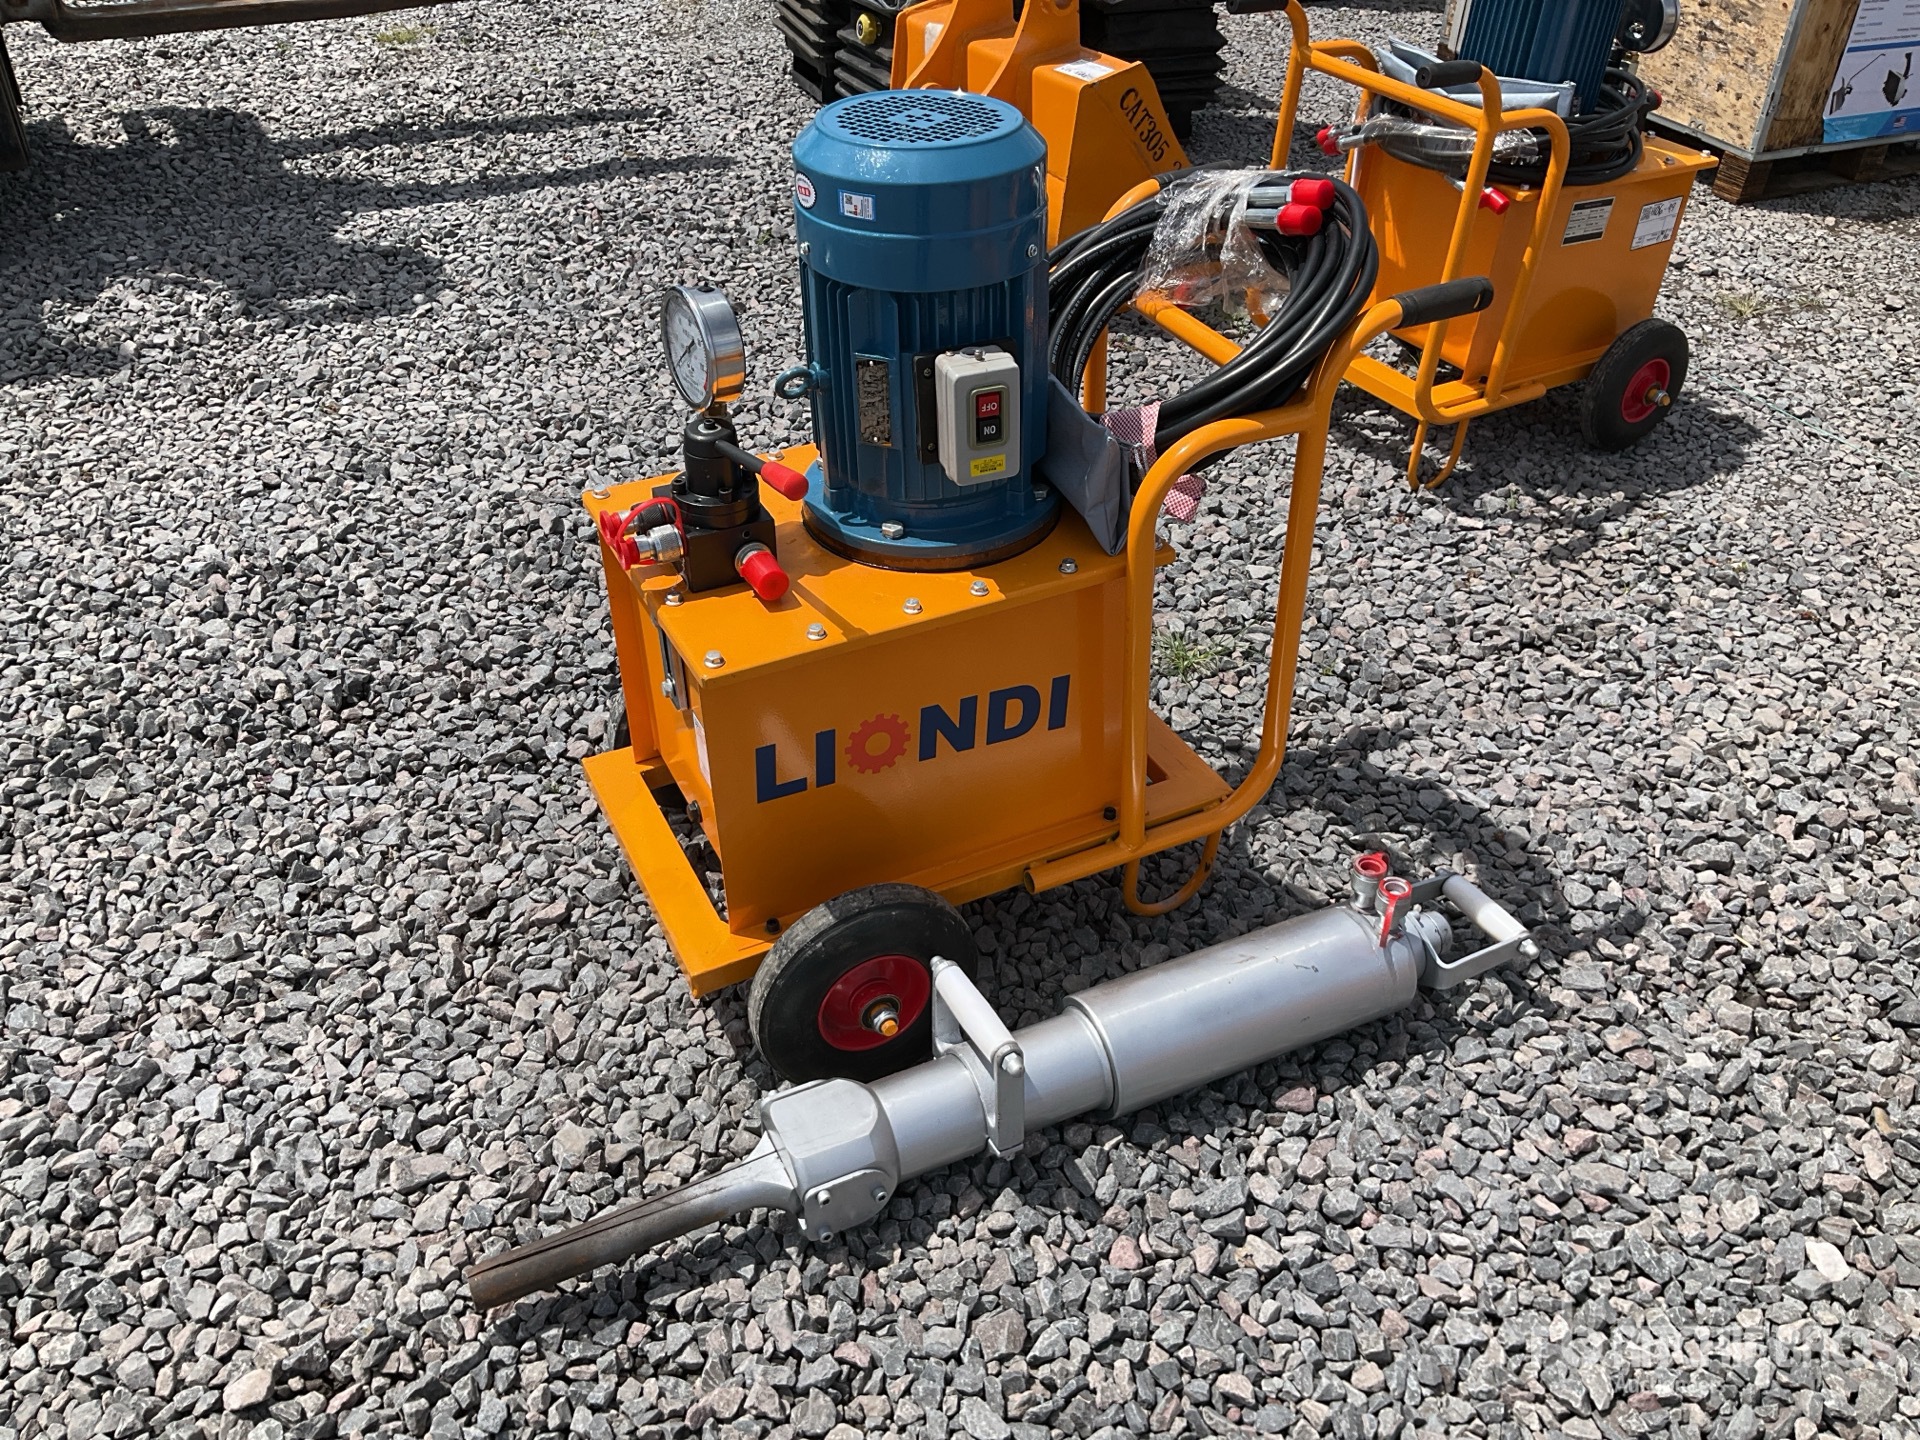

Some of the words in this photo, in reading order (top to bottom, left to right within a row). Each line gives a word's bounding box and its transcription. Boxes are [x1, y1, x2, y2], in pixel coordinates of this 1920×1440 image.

[1119, 87, 1170, 162] CAT305
[981, 402, 997, 412] OFF
[983, 425, 996, 435] ON
[755, 674, 1071, 804] LIONDI
